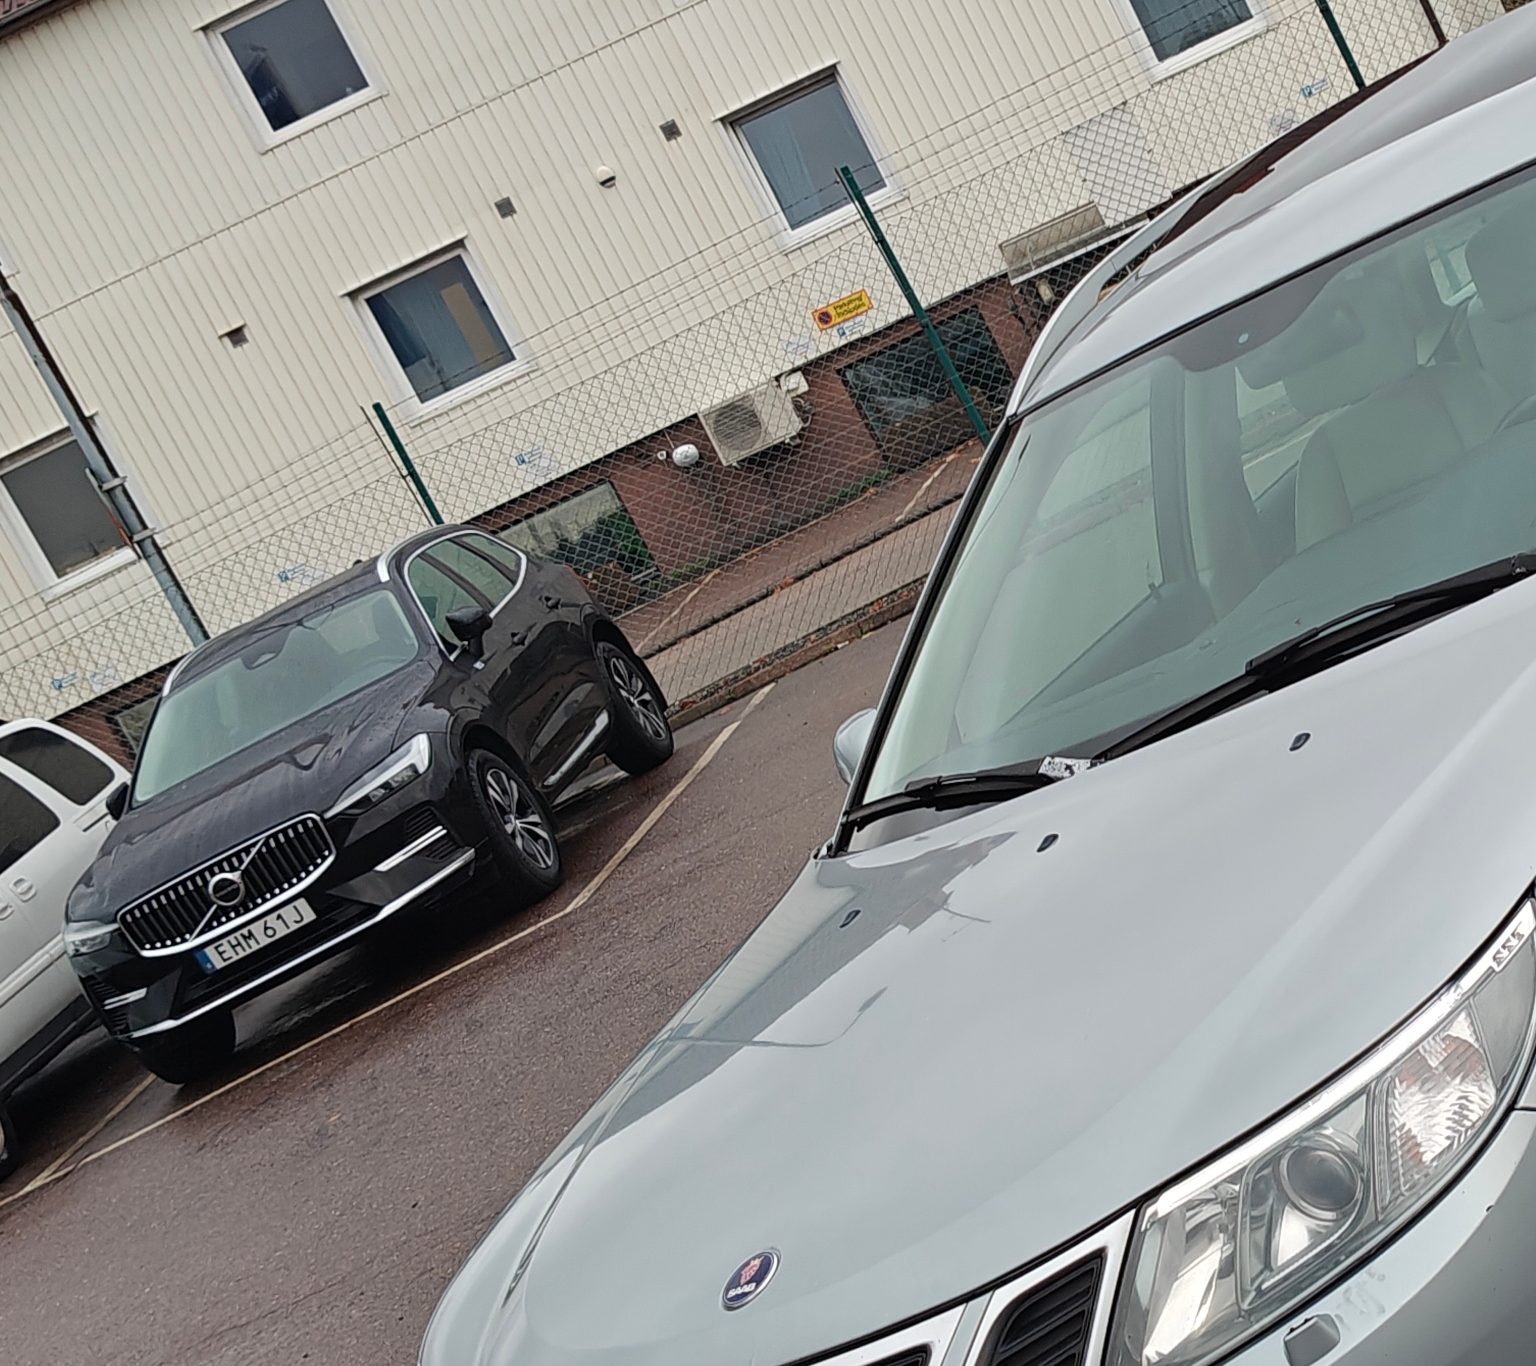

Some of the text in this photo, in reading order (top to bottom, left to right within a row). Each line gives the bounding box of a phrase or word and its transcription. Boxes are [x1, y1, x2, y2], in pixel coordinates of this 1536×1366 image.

[213, 904, 305, 963] EHM 61J
[726, 1282, 757, 1299] SAAB
